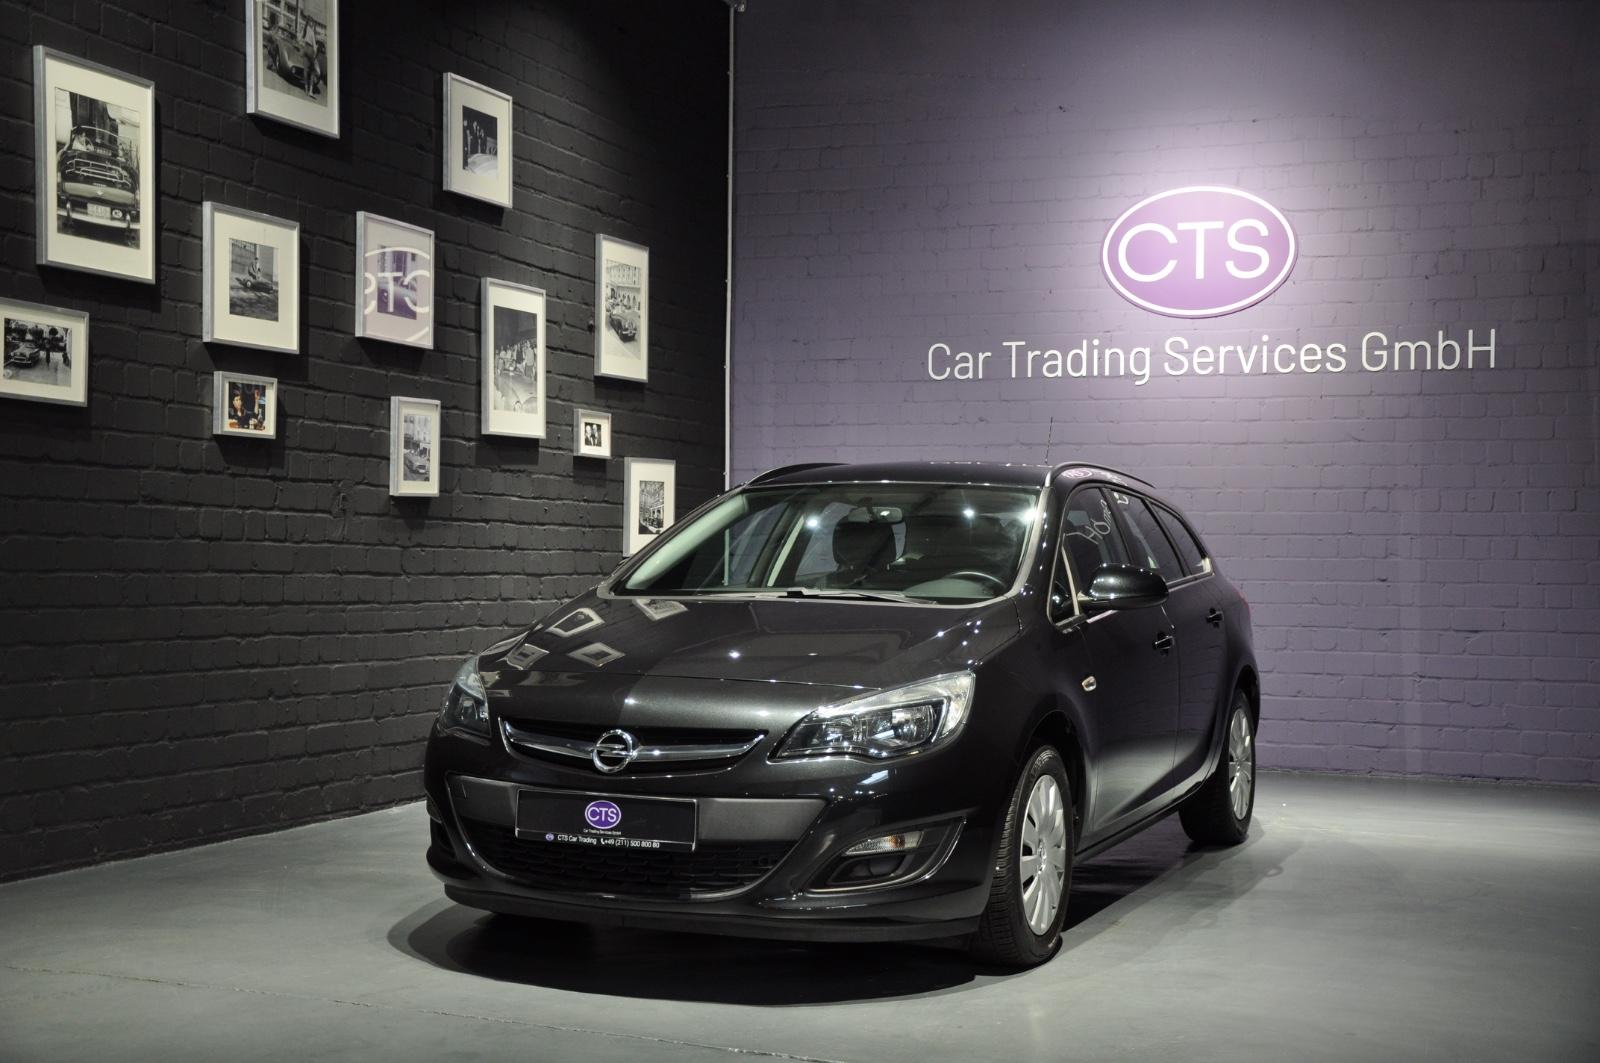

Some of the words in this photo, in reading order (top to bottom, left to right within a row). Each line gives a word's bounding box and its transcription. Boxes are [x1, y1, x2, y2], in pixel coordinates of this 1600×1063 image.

[1117, 218, 1271, 282] CTS
[927, 342, 991, 382] Car
[1002, 338, 1151, 386] Trading
[1164, 335, 1347, 376] Services
[1360, 328, 1496, 373] GmbH
[588, 806, 617, 822] CTS
[578, 836, 597, 845] Trading
[615, 839, 629, 848] (211)
